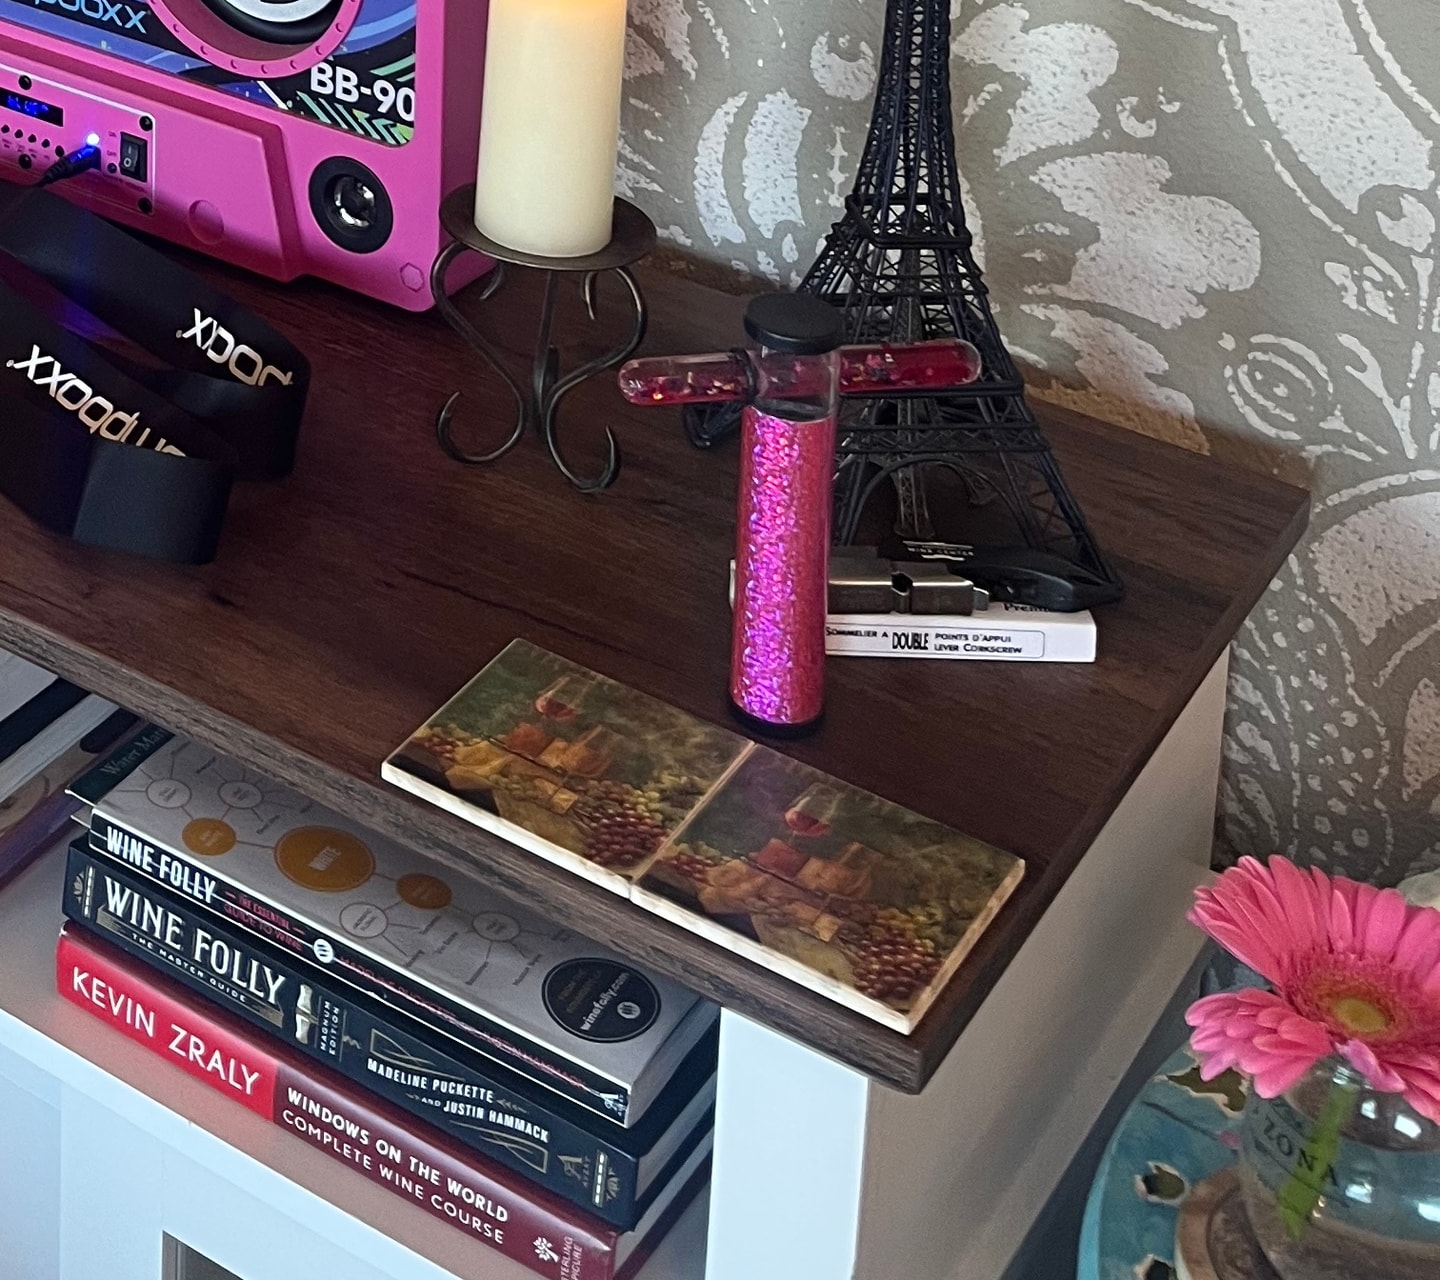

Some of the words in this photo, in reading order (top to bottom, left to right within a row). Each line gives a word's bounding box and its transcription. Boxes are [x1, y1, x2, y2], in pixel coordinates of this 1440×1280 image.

[825, 626, 877, 637] SOMMELIER
[891, 631, 929, 650] DOUBLE
[935, 633, 968, 641] POINTS
[972, 633, 1011, 643] D'APPUI
[934, 643, 959, 652] LEVER
[963, 643, 1022, 654] CORKSCREW
[107, 826, 154, 872] WINE
[159, 857, 216, 903] FOLLY
[104, 875, 185, 951] WINE
[194, 927, 287, 1006] FOLLY
[132, 932, 154, 949] THE
[159, 949, 205, 978] MASTER
[209, 977, 247, 1004] GUIDE
[72, 966, 155, 1038] KEVIN
[168, 1023, 259, 1096] ZRALY
[320, 1000, 331, 1051] MAGNUM
[328, 1007, 340, 1056] EDITION
[367, 1058, 428, 1090] MADELINE
[432, 1078, 494, 1104] PUCKETTE
[421, 1098, 442, 1108] AND
[443, 1099, 485, 1120] JUSTIN
[489, 1109, 549, 1144] HAMMACK
[282, 1109, 371, 1171] COMPLETE
[379, 1167, 424, 1200] WINE
[430, 1194, 505, 1244] COURSE
[288, 1086, 369, 1146] WINDOWS
[376, 1138, 401, 1164] ON
[409, 1156, 440, 1187] THE
[447, 1177, 509, 1223] WORLD
[571, 1243, 582, 1280] PICURE
